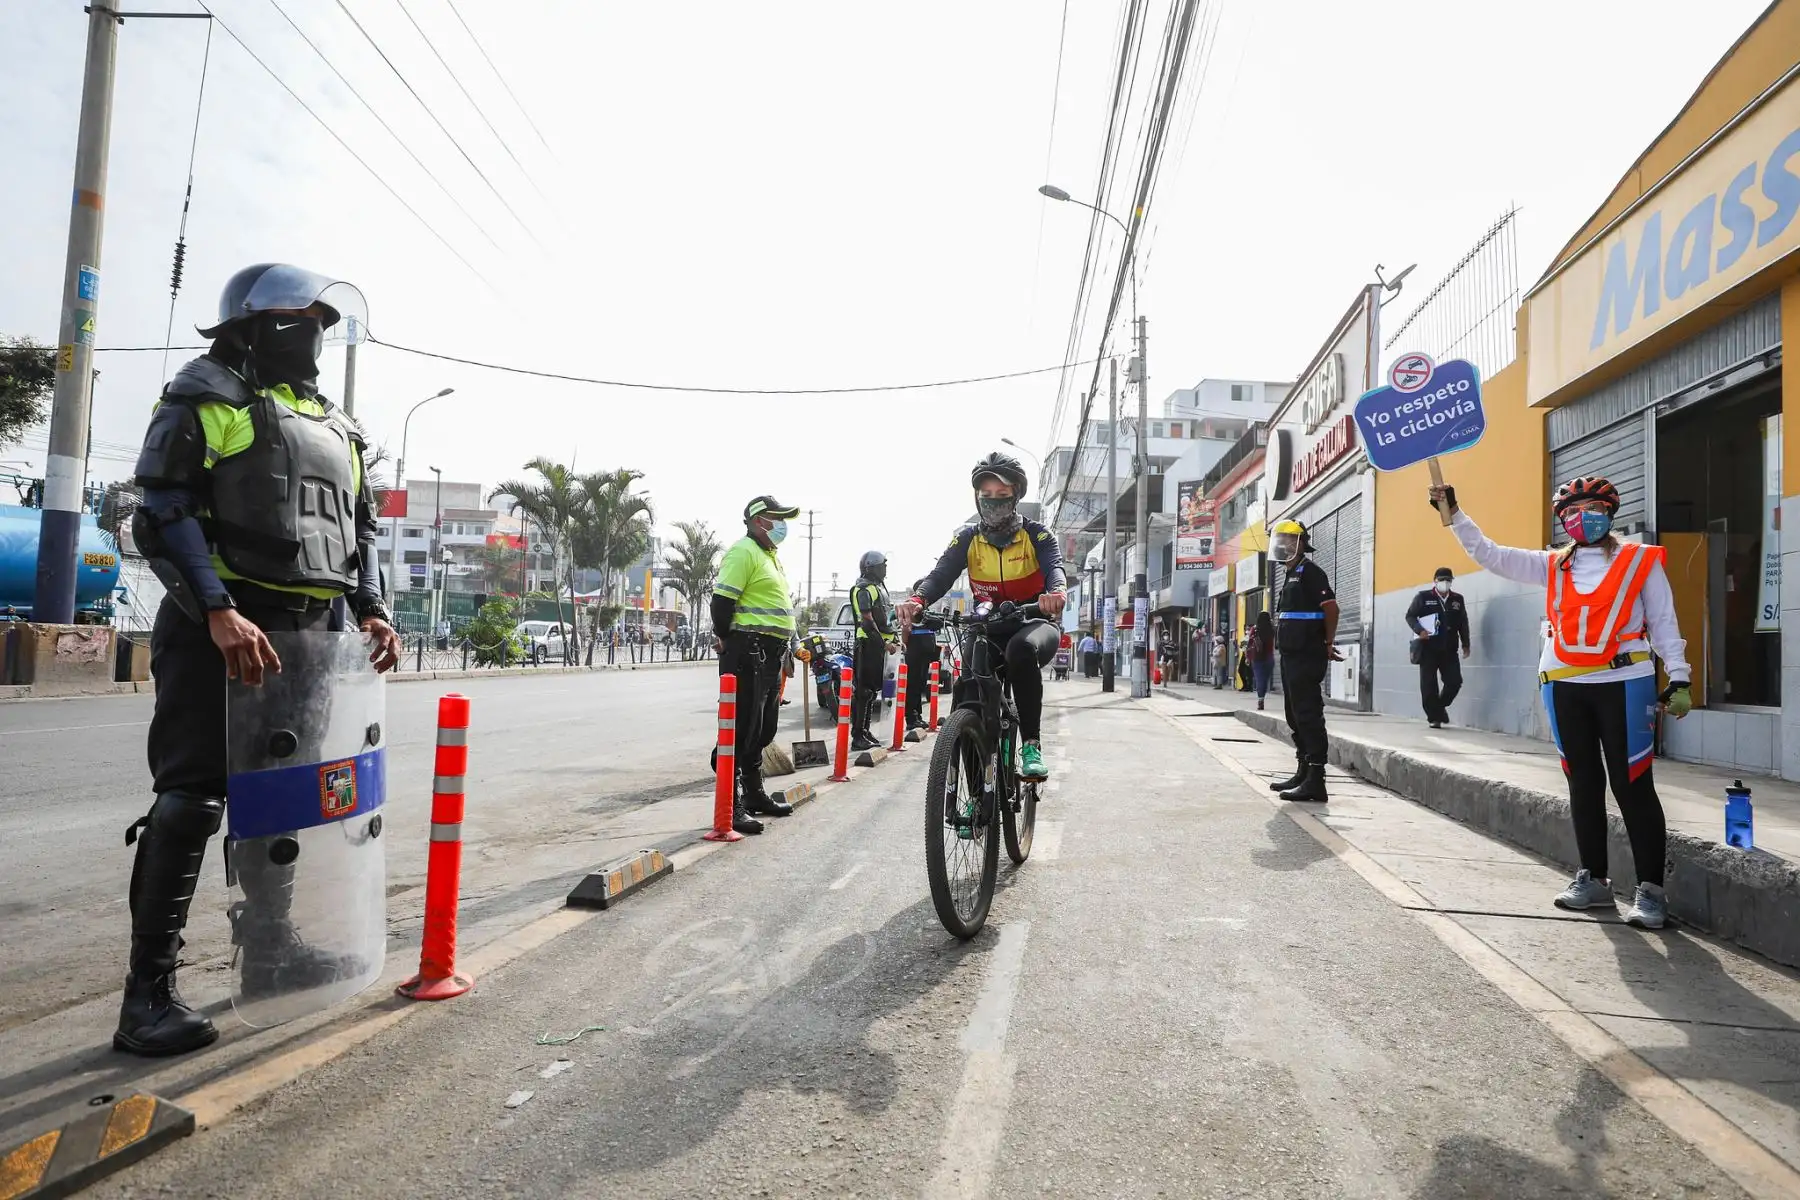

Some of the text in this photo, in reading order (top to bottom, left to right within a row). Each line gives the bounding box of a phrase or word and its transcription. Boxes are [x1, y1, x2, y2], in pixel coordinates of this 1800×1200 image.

[1590, 126, 1800, 353] Mass
[1302, 353, 1342, 435] CHIFA
[1364, 380, 1470, 428] Yo respeto
[1318, 415, 1347, 471] GALLINA
[1376, 399, 1476, 447] la ciclovía
